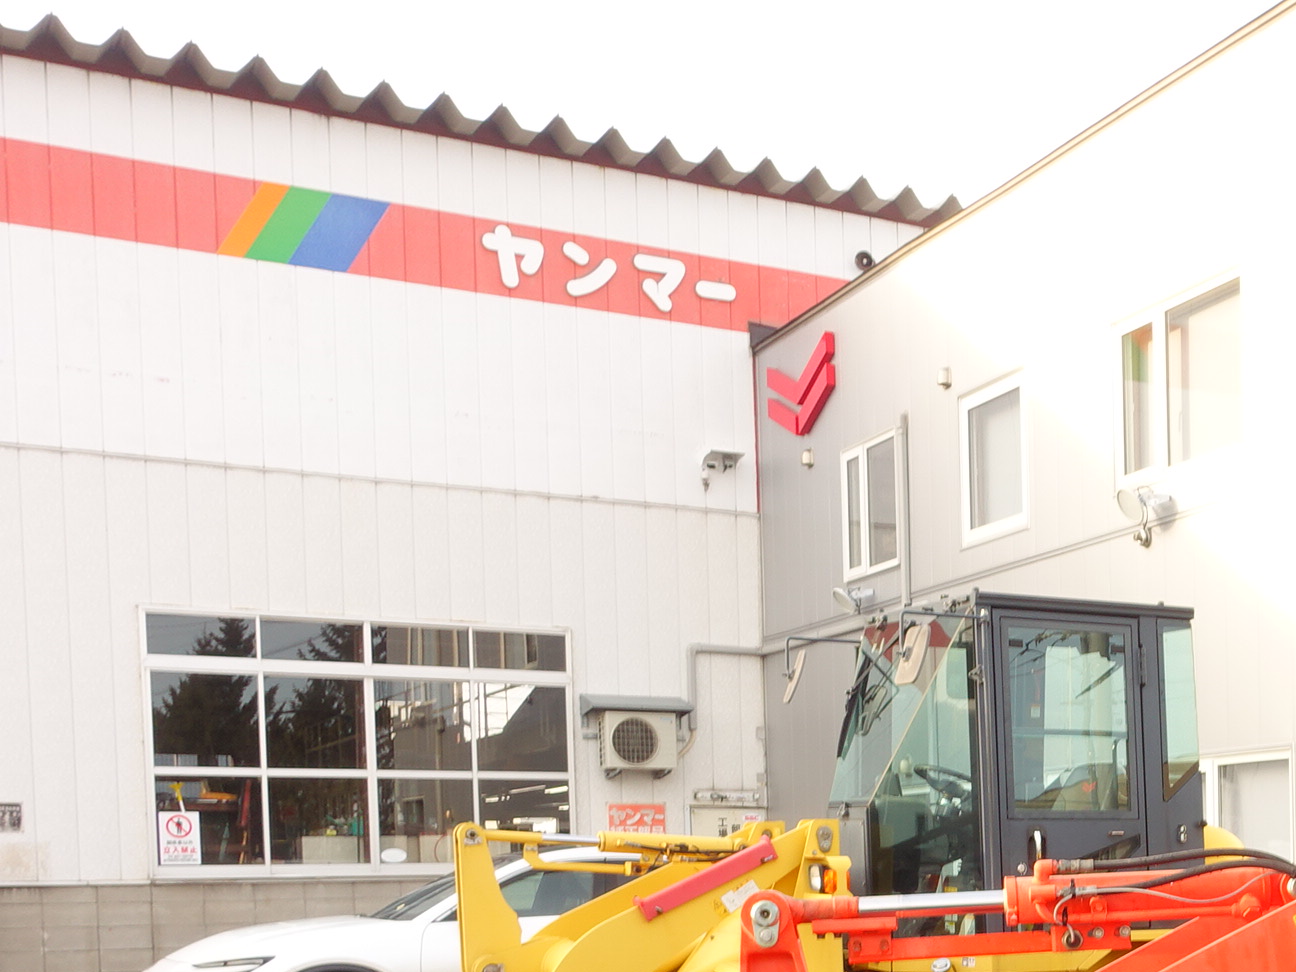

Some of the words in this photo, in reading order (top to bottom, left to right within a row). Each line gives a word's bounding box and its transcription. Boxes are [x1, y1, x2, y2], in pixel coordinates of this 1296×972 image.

[481, 224, 737, 313] ヤンマー
[609, 807, 664, 826] ヤンマー
